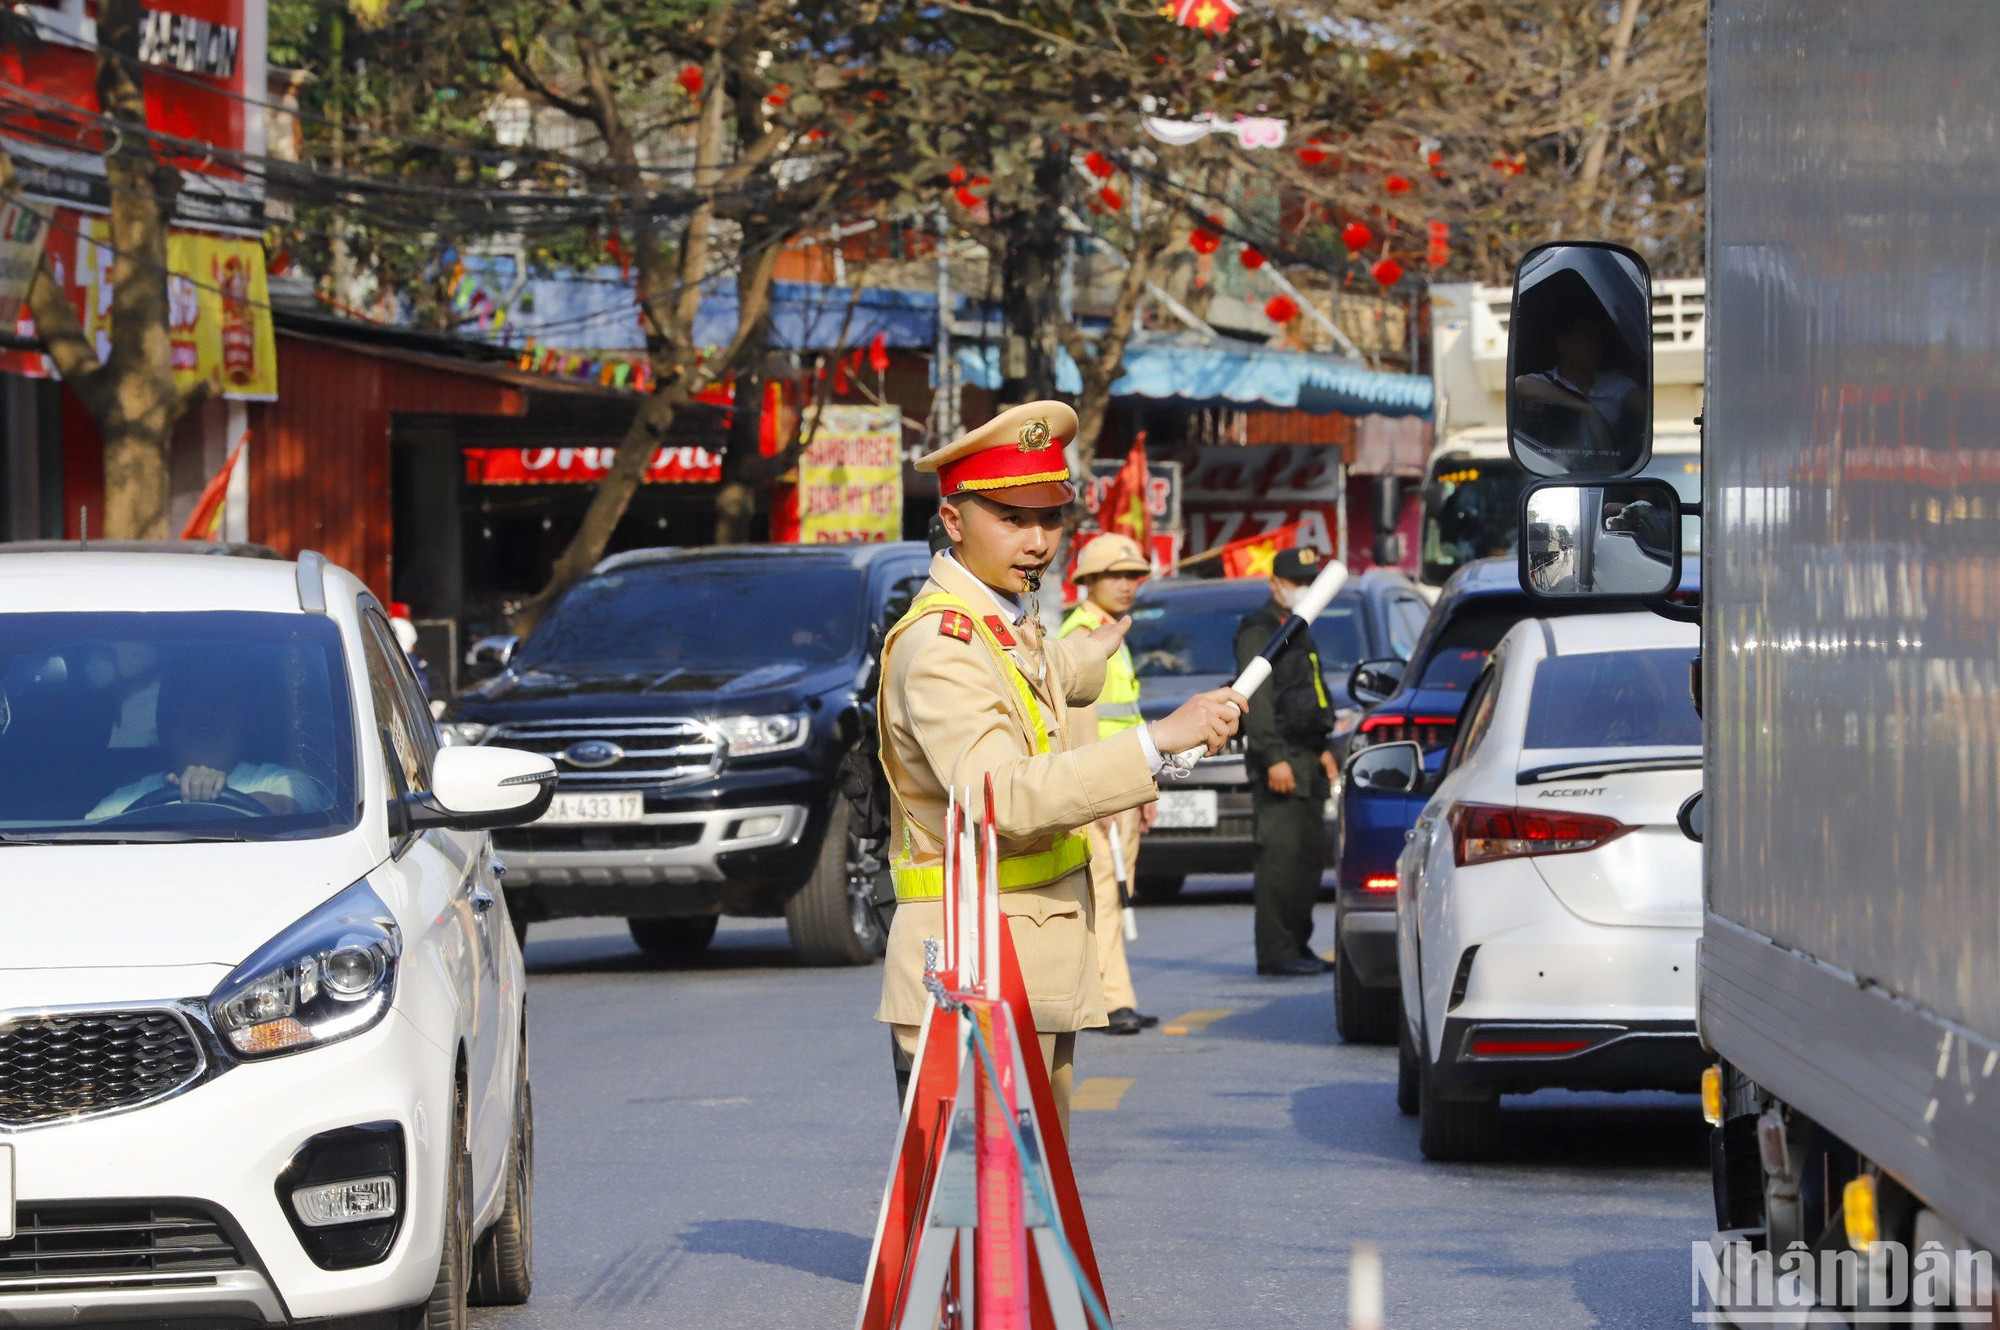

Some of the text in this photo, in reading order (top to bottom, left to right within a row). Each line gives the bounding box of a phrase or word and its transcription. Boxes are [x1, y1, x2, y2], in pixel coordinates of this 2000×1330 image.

[1184, 443, 1335, 498] afé
[1190, 510, 1333, 556] IZZA
[1538, 787, 1607, 798] ACCENT
